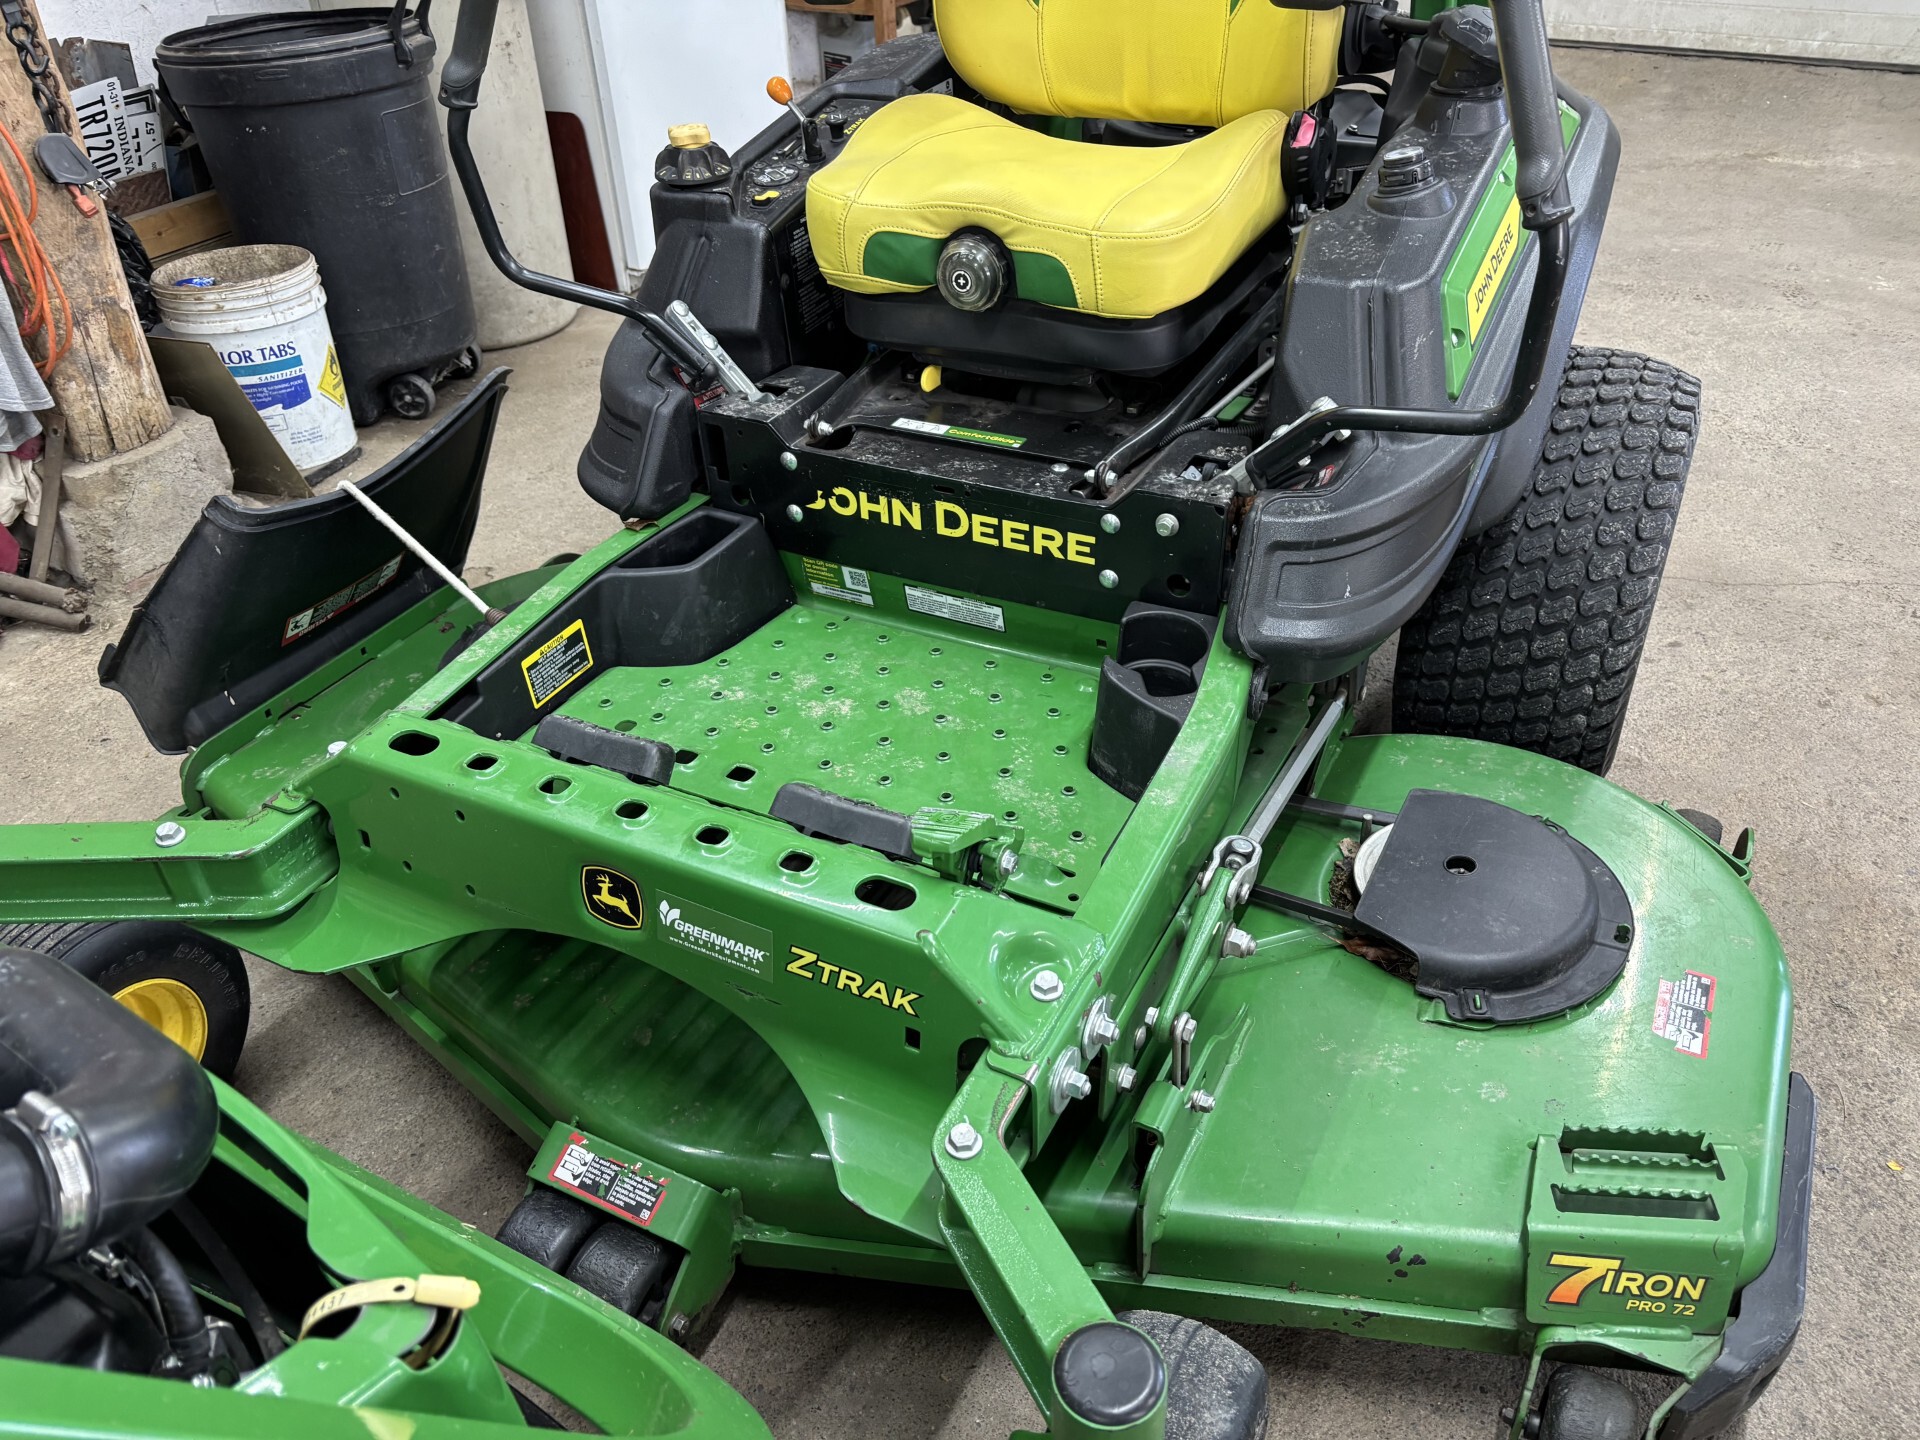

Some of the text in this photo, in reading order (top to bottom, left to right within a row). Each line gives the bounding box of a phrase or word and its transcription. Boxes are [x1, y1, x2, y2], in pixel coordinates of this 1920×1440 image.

[106, 81, 135, 175] 01-31 INDIANA
[843, 117, 866, 135] ZTRAK
[1475, 223, 1514, 313] JOHN DEERE
[219, 341, 296, 365] LOR TABS
[258, 368, 303, 382] SANITIZER
[805, 486, 1096, 565] JOHN DEERE
[543, 634, 564, 652] CAUTION
[669, 936, 760, 974] www.GreenMarkEquipment.com
[674, 919, 764, 962] GREENMARK
[681, 932, 757, 966] EQUIPMENT
[786, 946, 921, 1016] ZTRAK
[1626, 1300, 1696, 1316] PRO 72
